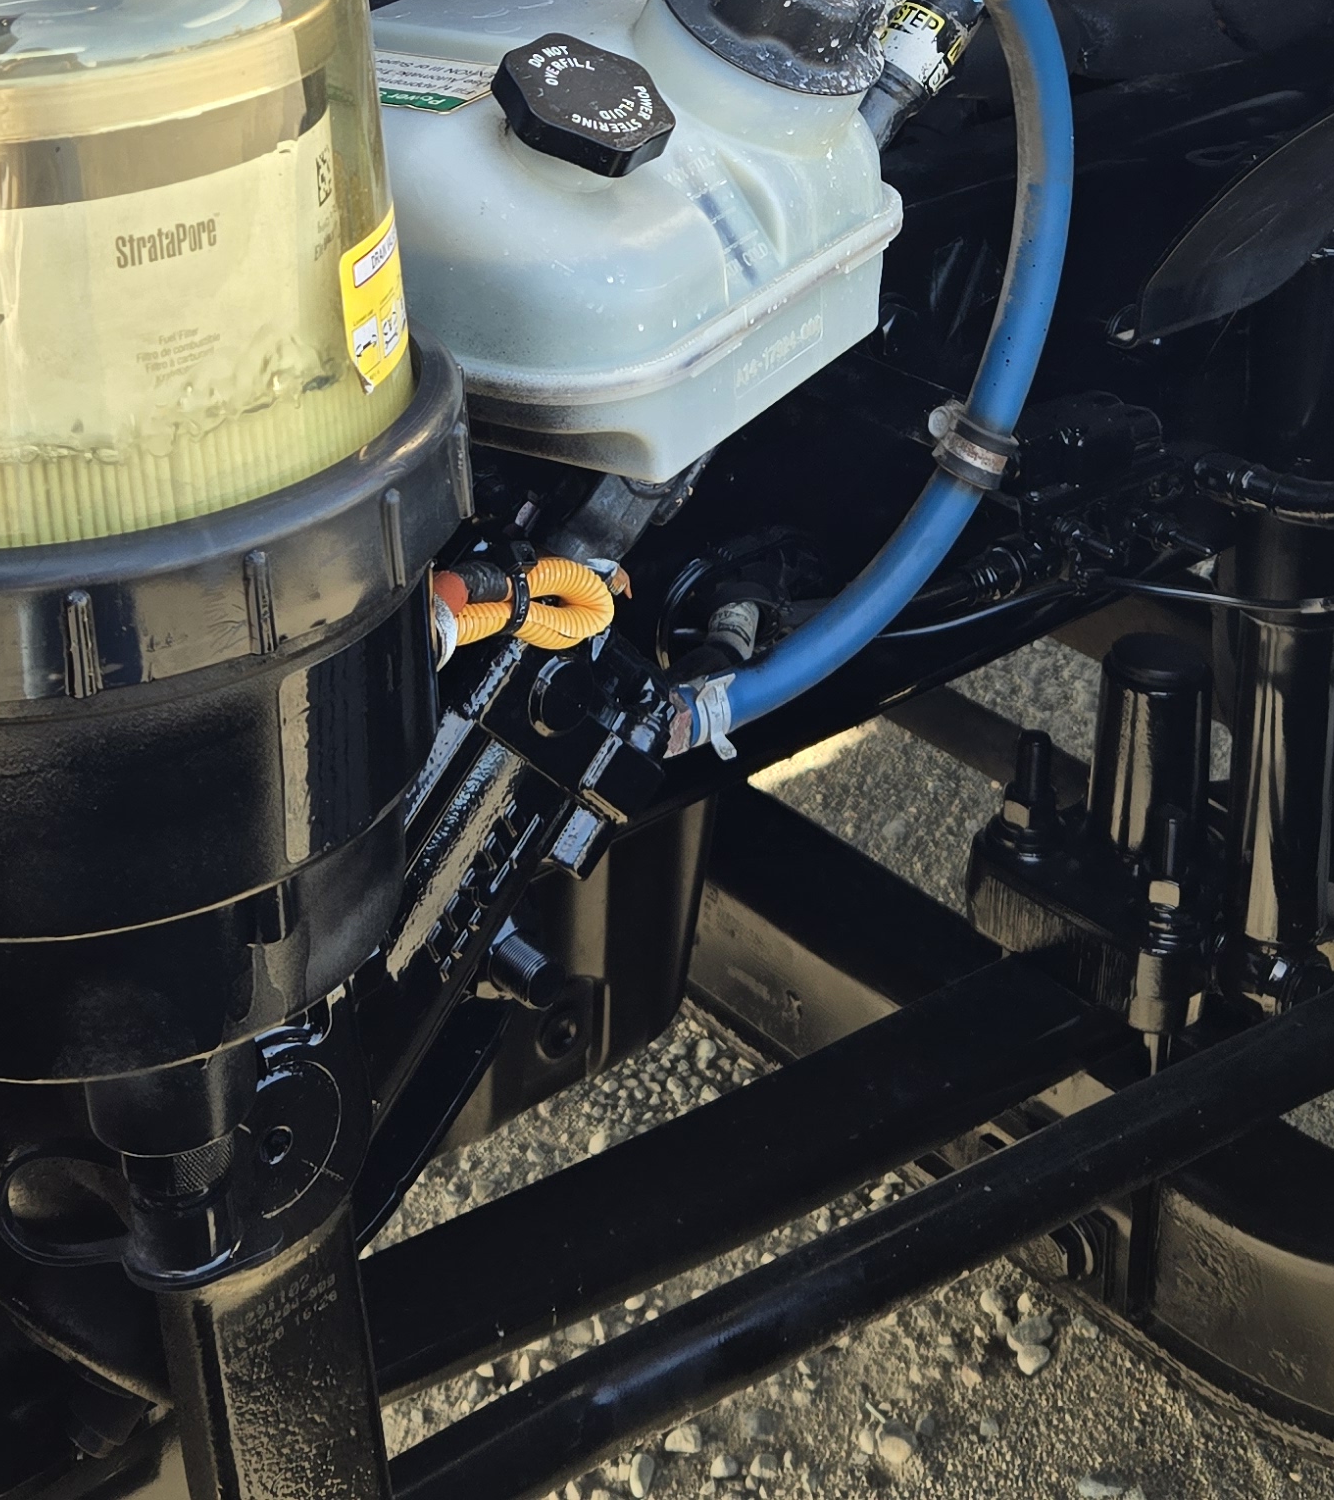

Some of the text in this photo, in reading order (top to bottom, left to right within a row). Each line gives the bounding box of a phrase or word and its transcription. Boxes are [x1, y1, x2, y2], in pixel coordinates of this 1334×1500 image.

[528, 44, 569, 68] DO NOT
[544, 56, 596, 87] OVERFILL
[571, 85, 655, 134] POWER STEERING
[598, 97, 635, 121] FLUID
[116, 216, 217, 270] StrataPore
